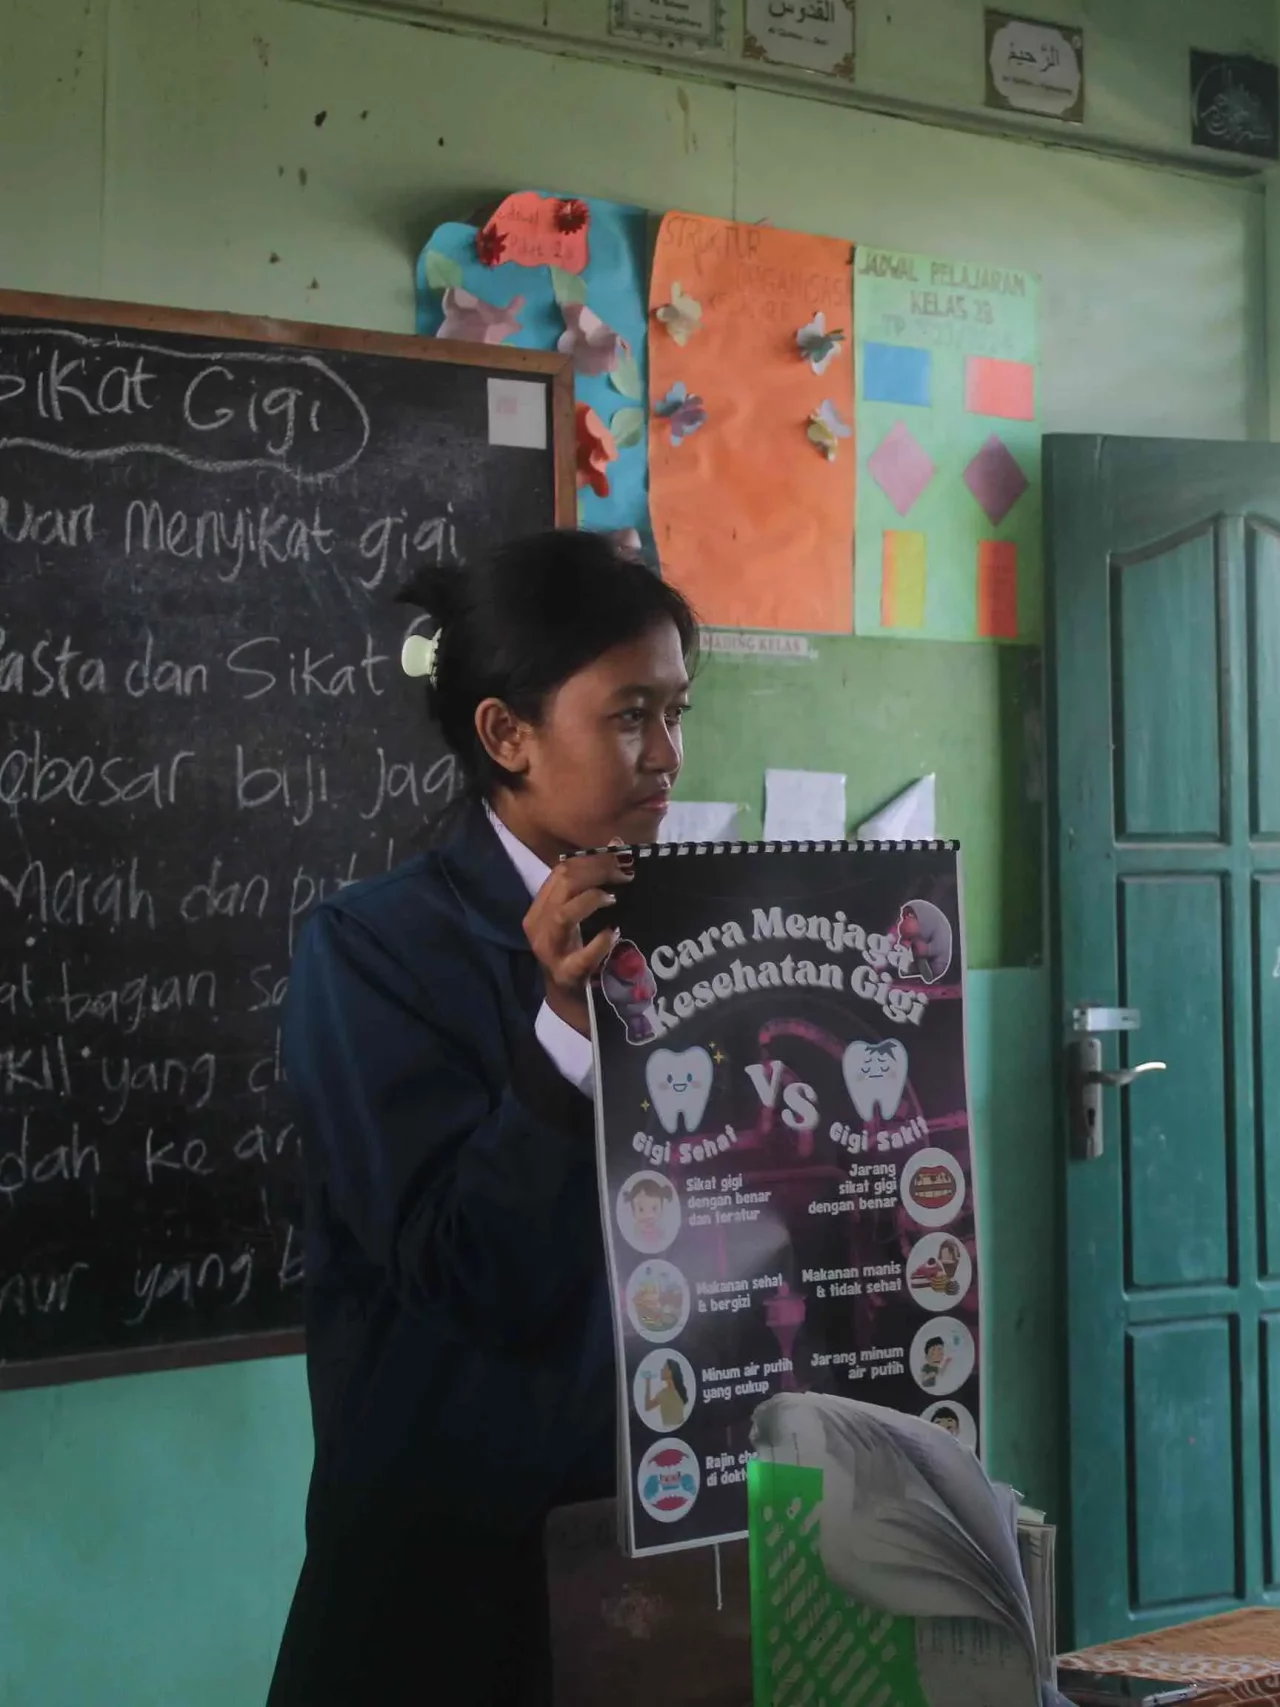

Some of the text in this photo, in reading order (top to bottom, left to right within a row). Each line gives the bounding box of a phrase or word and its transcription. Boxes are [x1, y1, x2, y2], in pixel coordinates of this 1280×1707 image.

[858, 252, 1027, 298] JADWAL PELAJARAN
[910, 289, 969, 322] KELAS
[184, 366, 321, 456] Gigi
[0, 628, 106, 699] asta
[124, 628, 208, 697] dan
[180, 855, 270, 924] dan
[650, 905, 915, 981] Cara Menjaga
[640, 953, 930, 1039] Kesehatan Gigi
[102, 1052, 217, 1126] yang
[744, 1059, 821, 1134] VS
[632, 1124, 738, 1165] Gigi Sehat
[829, 1115, 930, 1154] Gigi Sakit
[146, 1127, 214, 1185] ke
[686, 1173, 743, 1192] Sikat gigi
[849, 1163, 896, 1178] Jarang
[838, 1177, 898, 1195] sikat gigi
[687, 1190, 772, 1211] dengan benar
[808, 1195, 898, 1216] dengan benar
[689, 1208, 761, 1227] dan teratur
[696, 1272, 783, 1295] Makanan sehat
[801, 1260, 901, 1283] Makanan manis
[124, 1247, 253, 1327] yang
[816, 1277, 902, 1298] & tidak sehat
[698, 1293, 752, 1313] & bergizi
[810, 1345, 905, 1367] Jarang minum
[702, 1357, 793, 1382] Minum air putih
[848, 1361, 905, 1380] air putih
[703, 1379, 770, 1404] yang cukup
[705, 1452, 736, 1473] Rajin
[706, 1467, 747, 1487] di dokt
